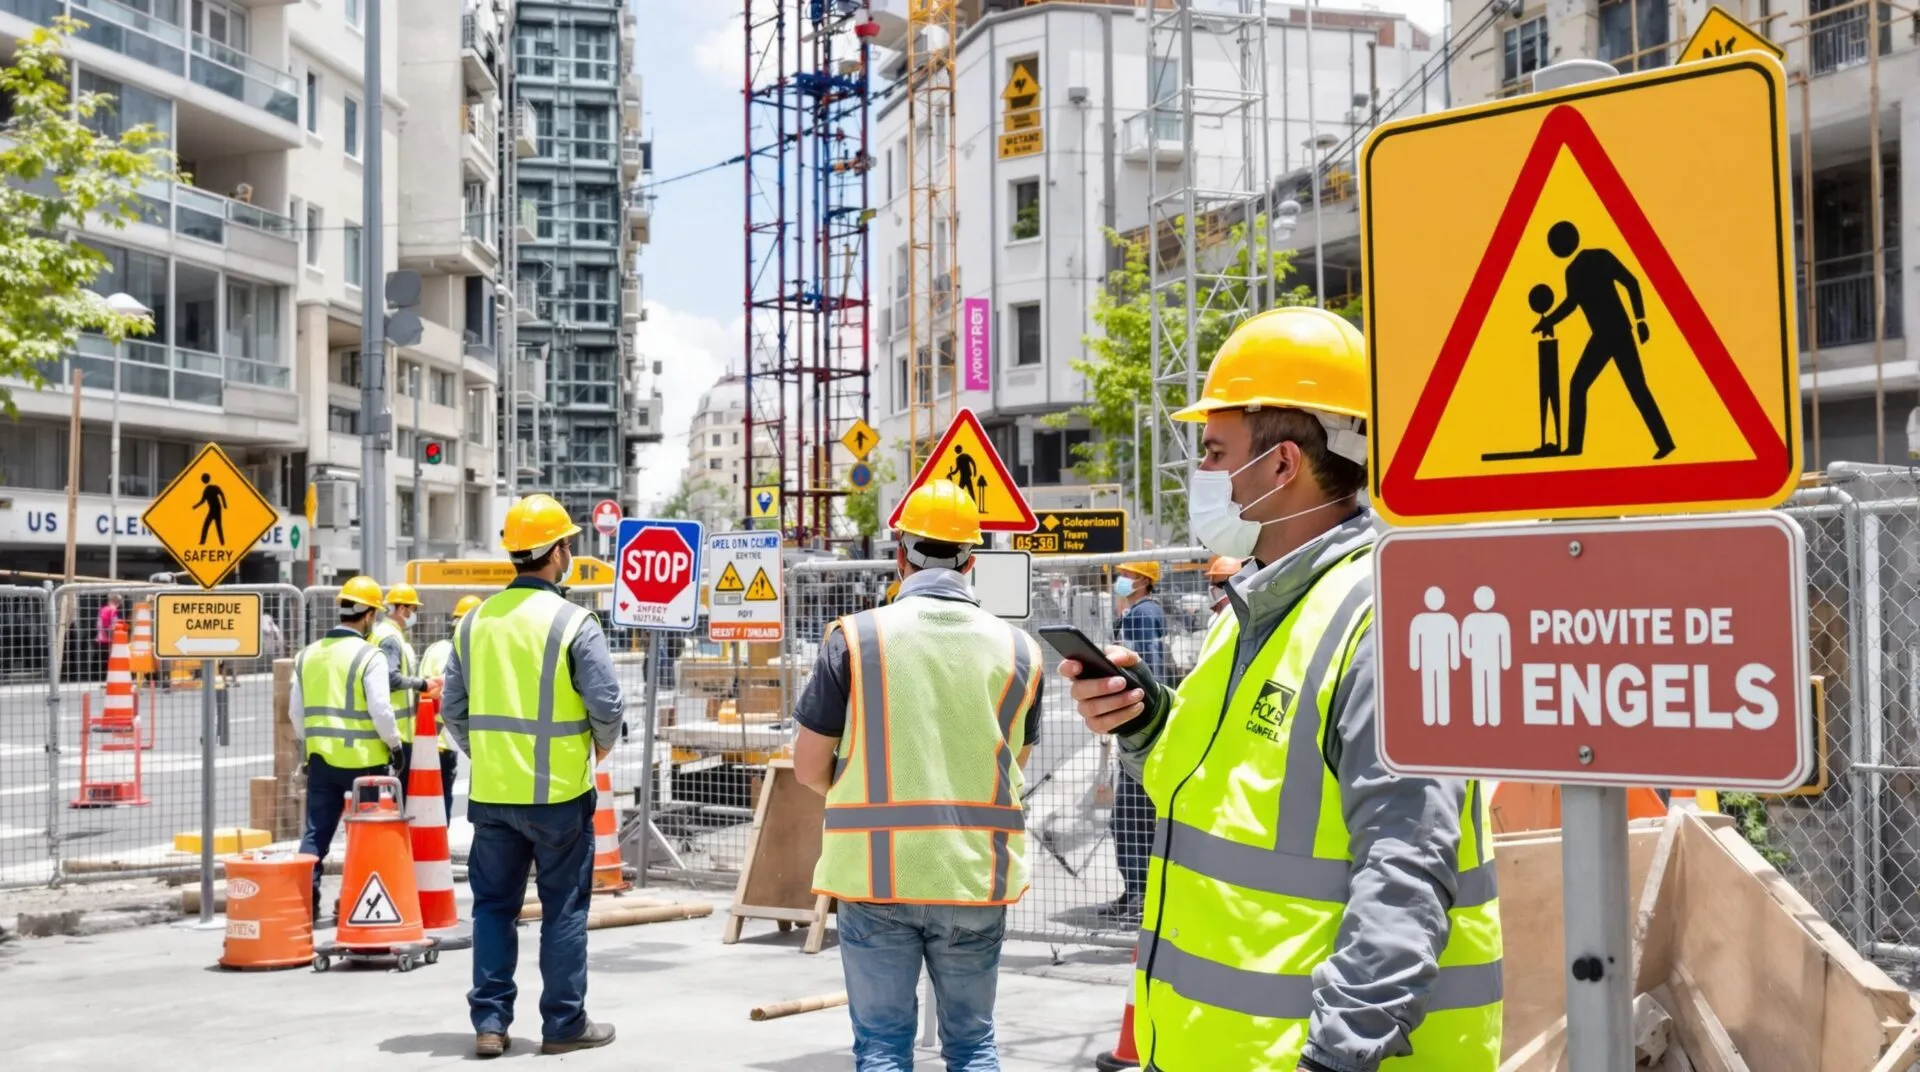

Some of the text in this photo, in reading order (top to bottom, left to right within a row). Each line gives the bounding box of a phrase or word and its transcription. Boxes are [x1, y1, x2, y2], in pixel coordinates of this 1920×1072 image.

[27, 511, 57, 532] US
[183, 549, 234, 562] SAFERY
[625, 549, 689, 584] STOP
[172, 602, 241, 614] EMFERIDUE
[185, 618, 234, 630] CAMPLE
[1530, 608, 1734, 644] PROVITE DE
[1522, 662, 1779, 730] ENGELS
